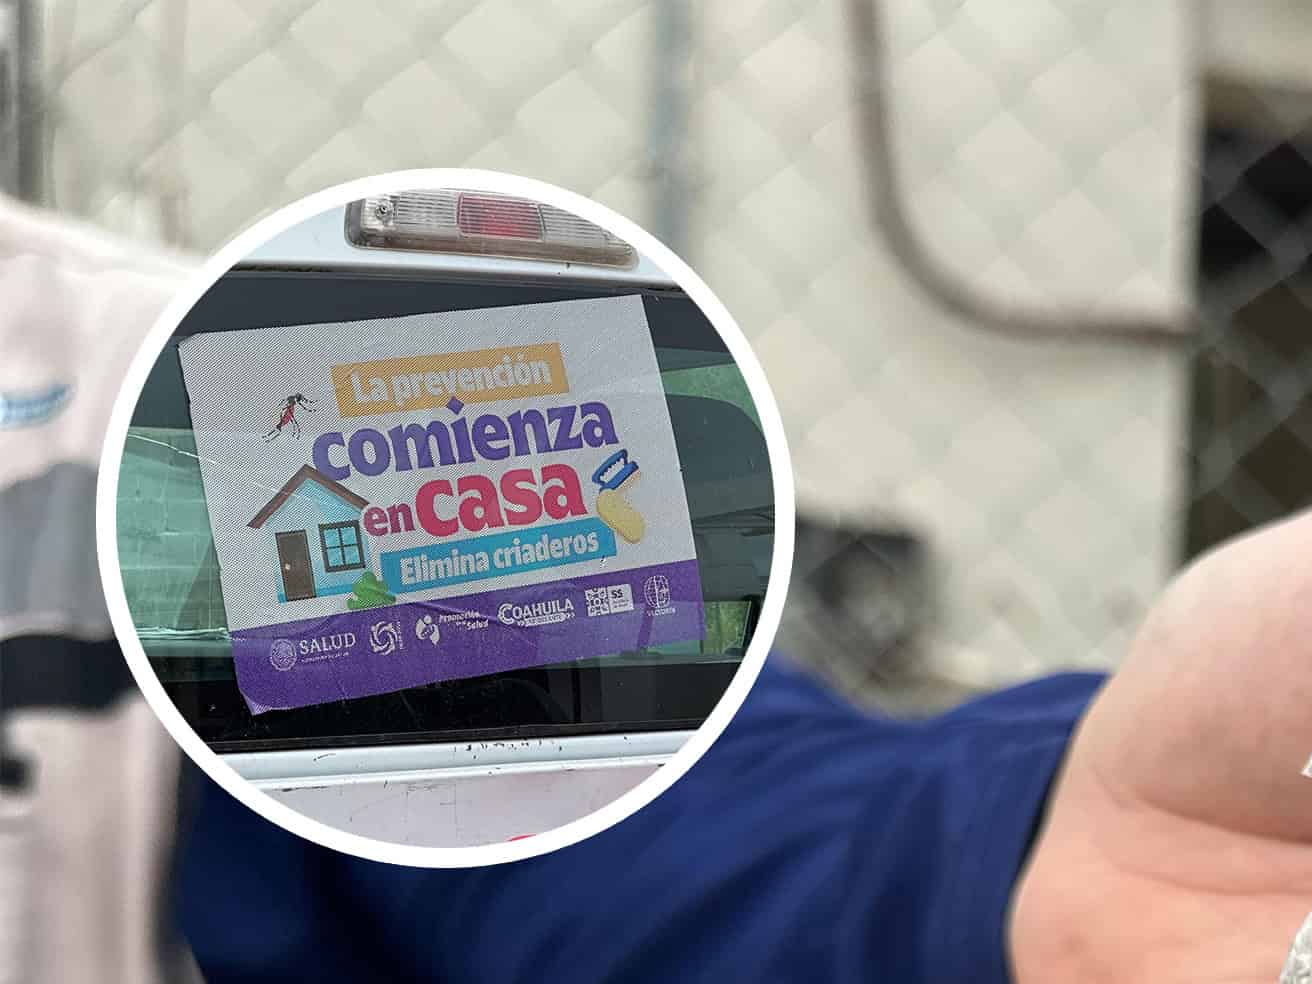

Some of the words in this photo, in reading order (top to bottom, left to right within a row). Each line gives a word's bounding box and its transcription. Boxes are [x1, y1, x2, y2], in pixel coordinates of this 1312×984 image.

[350, 368, 389, 404] La
[392, 353, 550, 406] prevención
[312, 397, 618, 481] comienza
[363, 502, 415, 536] en
[416, 464, 587, 537] casa
[400, 549, 489, 584] Elimina
[494, 531, 598, 569] criaderos
[498, 599, 574, 624] COAHUILA
[299, 632, 356, 655] SALUD
